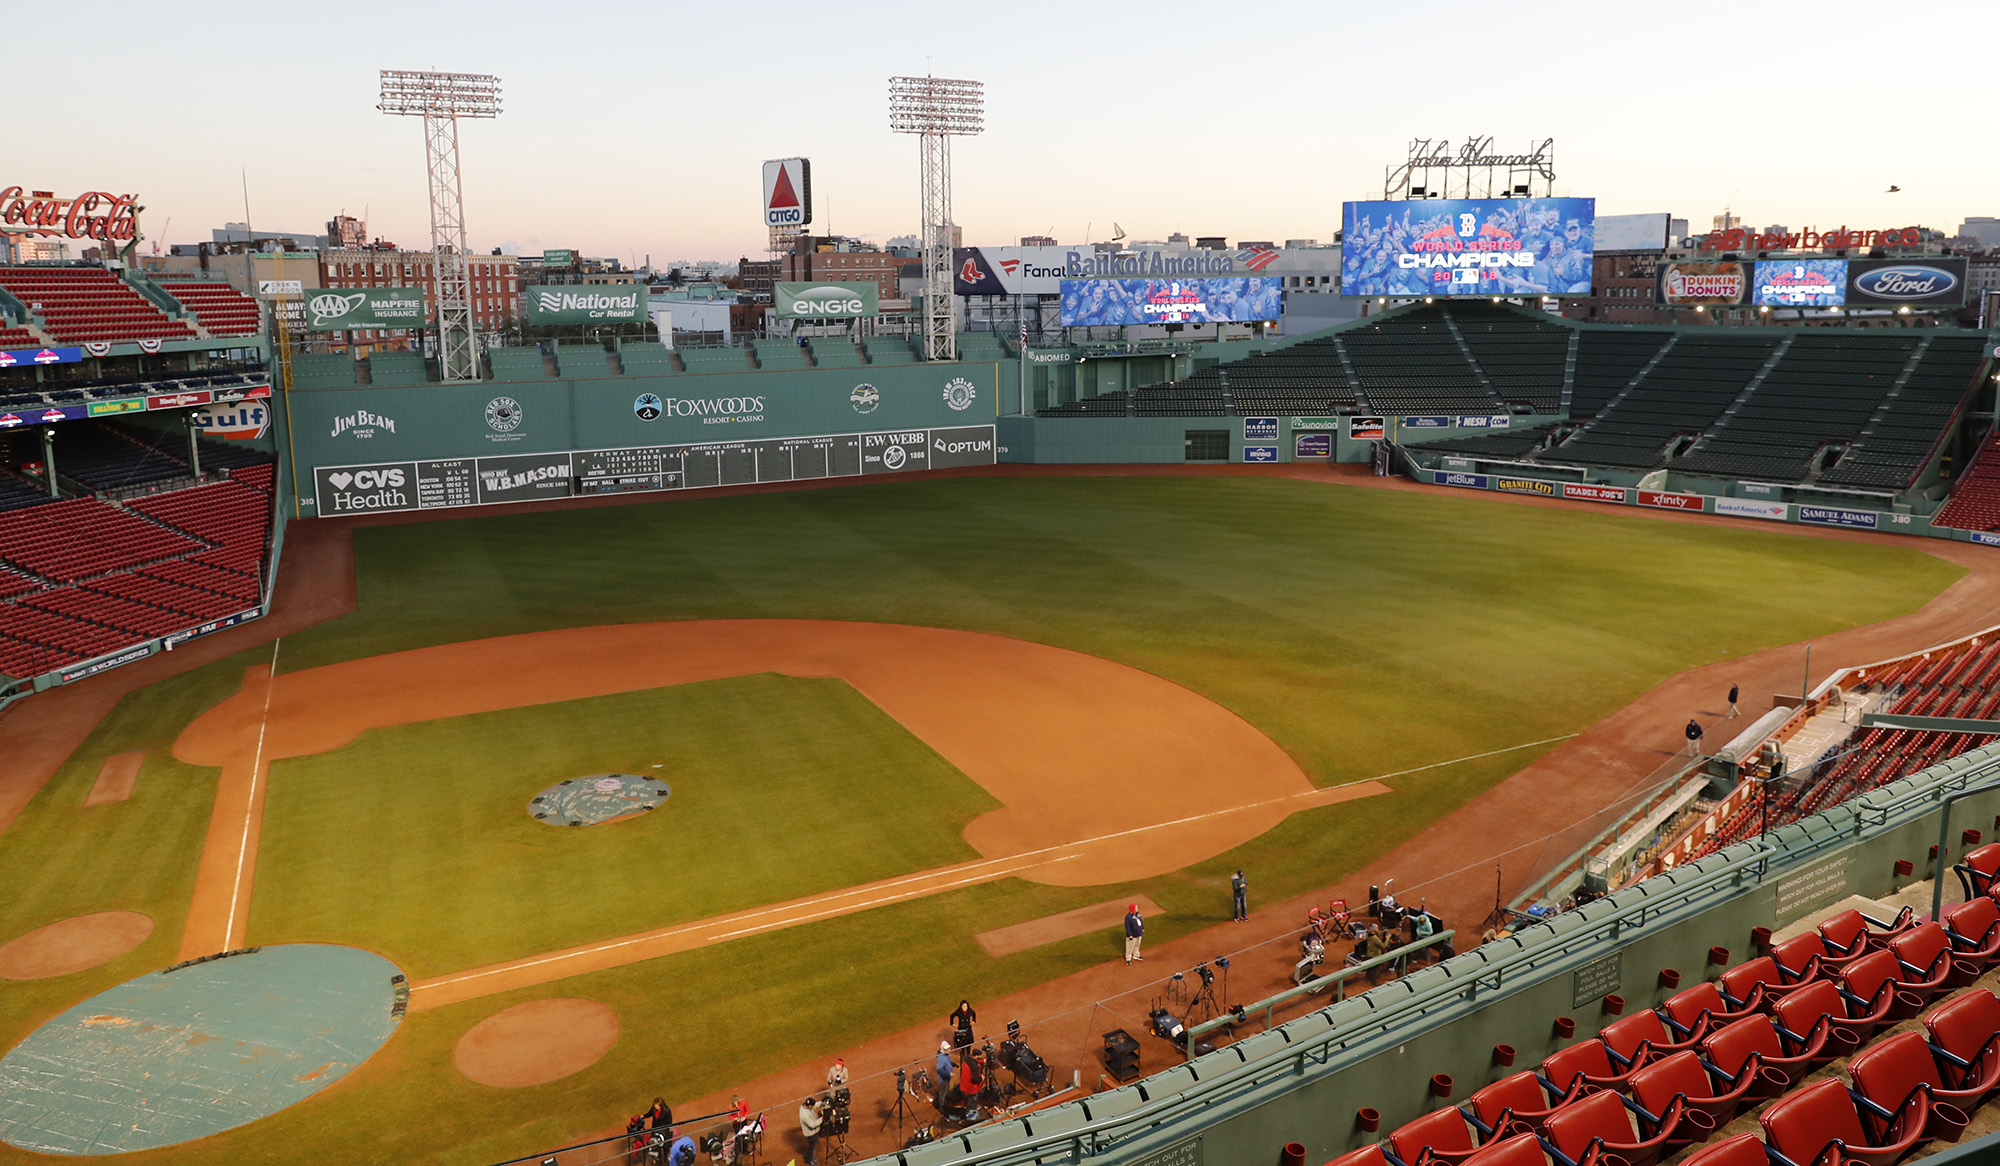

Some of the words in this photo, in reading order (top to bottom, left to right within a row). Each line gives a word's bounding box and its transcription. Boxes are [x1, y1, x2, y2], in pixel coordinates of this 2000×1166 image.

[1386, 137, 1452, 194] John
[1453, 134, 1556, 181] Hancock
[0, 186, 139, 240] Coca-Cola
[769, 208, 800, 223] CITGO
[1413, 241, 1464, 252] WORLD
[1469, 240, 1522, 251] SERIES
[1066, 251, 1124, 276] Bank
[1124, 251, 1147, 276] of
[1149, 251, 1233, 275] America
[1399, 252, 1535, 269] CHAMPIONS
[1433, 272, 1451, 281] 20
[1481, 271, 1497, 280] 18
[1687, 275, 1741, 287] DUNKIN'
[1874, 271, 1936, 293] Ford
[1687, 287, 1735, 297] DONUTS
[1761, 285, 1836, 294] CHAMPIONS
[315, 294, 346, 316] AAA
[371, 300, 420, 308] MAPFRE
[1144, 303, 1206, 314] CHAMPIONS
[275, 310, 300, 319] HOME
[589, 310, 605, 318] Car
[607, 310, 634, 318] Rental
[1034, 353, 1070, 362] ABIOMED
[487, 401, 499, 415] RED
[500, 399, 515, 408] SOX
[666, 395, 764, 417] FOXWOODS
[194, 408, 263, 428] Gulf
[331, 415, 356, 438] JIM
[357, 410, 396, 434] BEAM
[489, 410, 521, 430] SCHOLARS
[703, 416, 730, 425] RESORT
[736, 414, 764, 423] CASINO
[1463, 416, 1487, 427] NESN
[1351, 422, 1383, 430] Safelite
[888, 432, 925, 445] WEBB
[948, 440, 991, 453] OPTUM
[593, 450, 631, 458] FENWAY
[865, 455, 881, 463] Since
[354, 468, 406, 490] CVS
[480, 471, 495, 479] WHO
[1446, 473, 1476, 486] jetBlue
[536, 481, 554, 489] SINCE
[1499, 479, 1534, 490] GRANITE
[1535, 482, 1553, 494] CITY
[333, 489, 408, 511] Health
[1566, 487, 1598, 497] TRADER
[1600, 489, 1624, 500] JOE'S
[300, 497, 315, 506] 310
[1652, 493, 1688, 508] xfinity
[1717, 503, 1733, 511] Bank
[1733, 504, 1740, 512] of
[1739, 505, 1767, 514] America
[1802, 508, 1840, 519] SAMUEL
[1840, 511, 1875, 524] ADAMS
[1892, 514, 1911, 524] 380
[97, 656, 124, 670] WORLD
[1777, 876, 1803, 892] WARNING
[1803, 871, 1815, 881] FOR
[1814, 865, 1829, 876] YOUR
[1829, 856, 1849, 870] SAFETY
[1780, 892, 1795, 902] WATCH
[1795, 887, 1805, 896] OUT
[1805, 883, 1815, 891] FOR
[1815, 877, 1827, 886] FOUL
[1826, 871, 1840, 881] BALLS
[1776, 903, 1793, 916] PLEASE
[1793, 900, 1801, 908] DO
[1800, 895, 1810, 904] NOT
[1809, 889, 1825, 901] REACH
[1825, 883, 1837, 893] OVER
[1162, 1150, 1179, 1162] OUT
[1180, 1142, 1197, 1154] FOR
